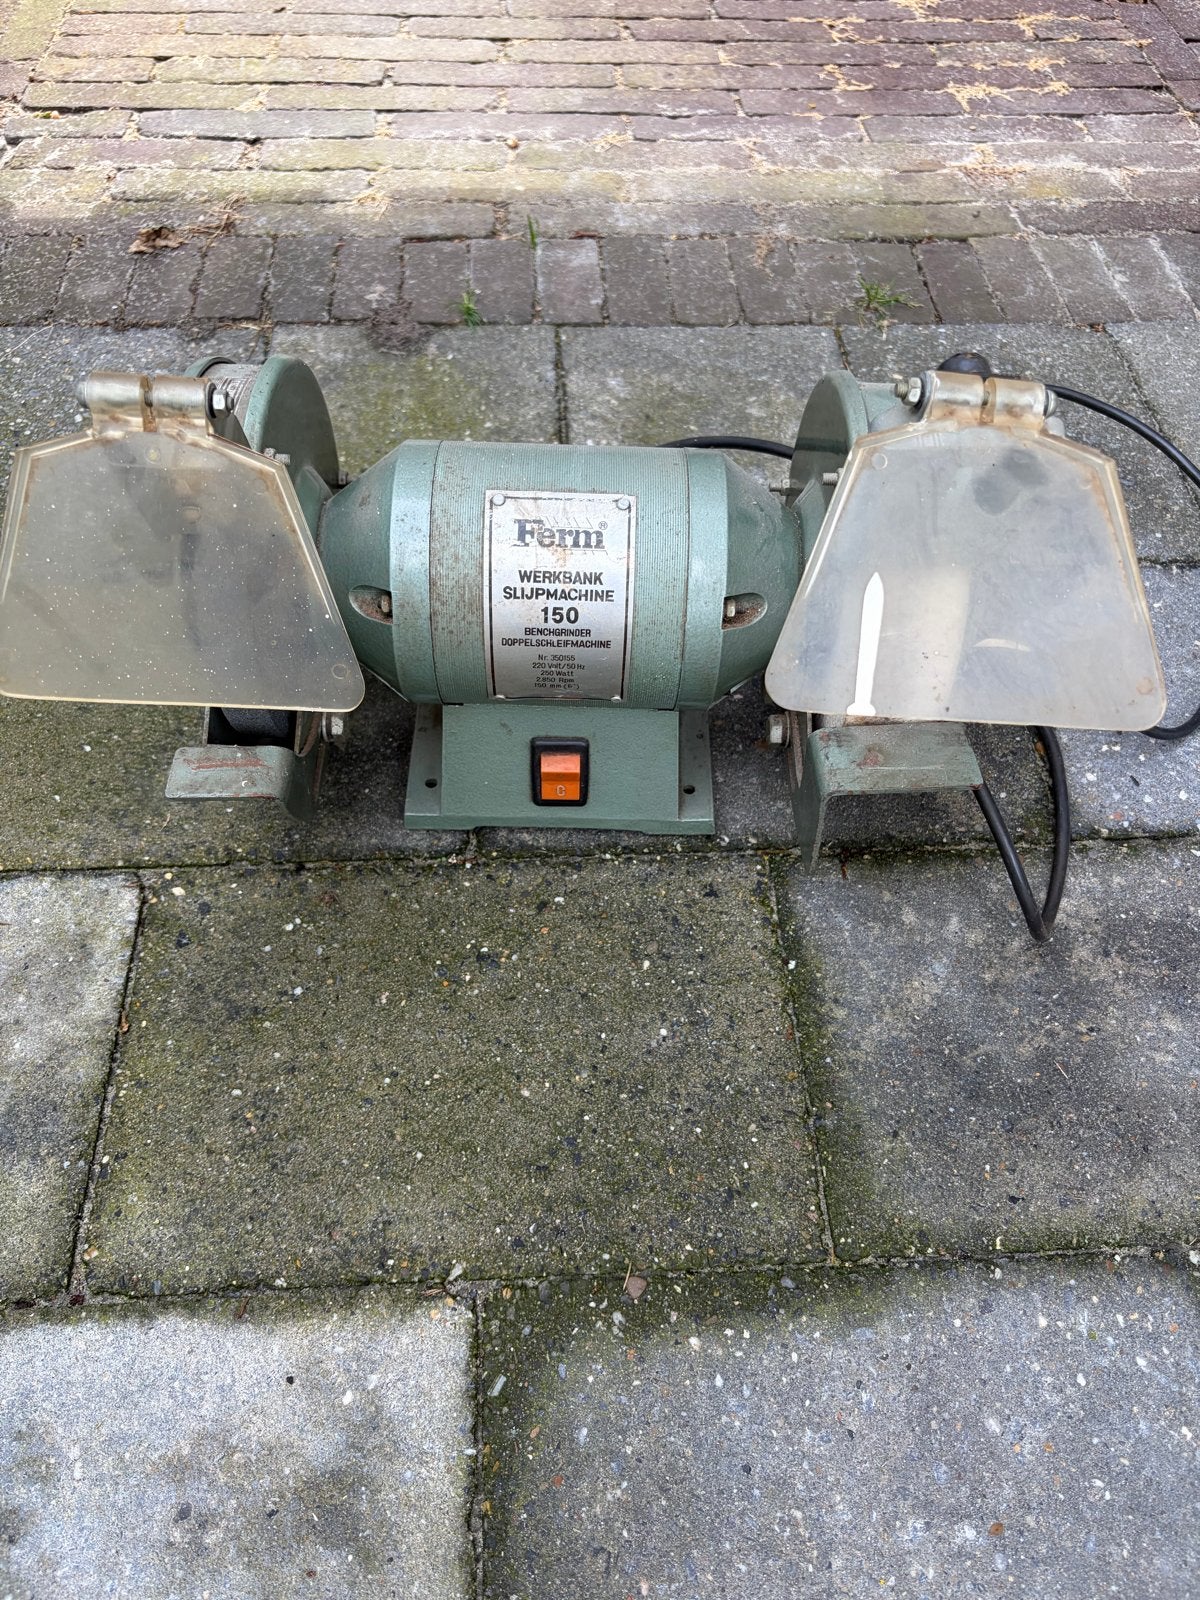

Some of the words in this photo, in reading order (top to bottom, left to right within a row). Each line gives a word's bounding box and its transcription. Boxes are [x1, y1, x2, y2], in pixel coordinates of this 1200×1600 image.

[518, 570, 603, 586] WERKBANK
[503, 586, 614, 602] SLIJPMACHINE
[541, 606, 579, 624] 150
[524, 627, 591, 637] BENCHGRINDER
[502, 638, 611, 649] DOPPELSCHLEIFMACHINE
